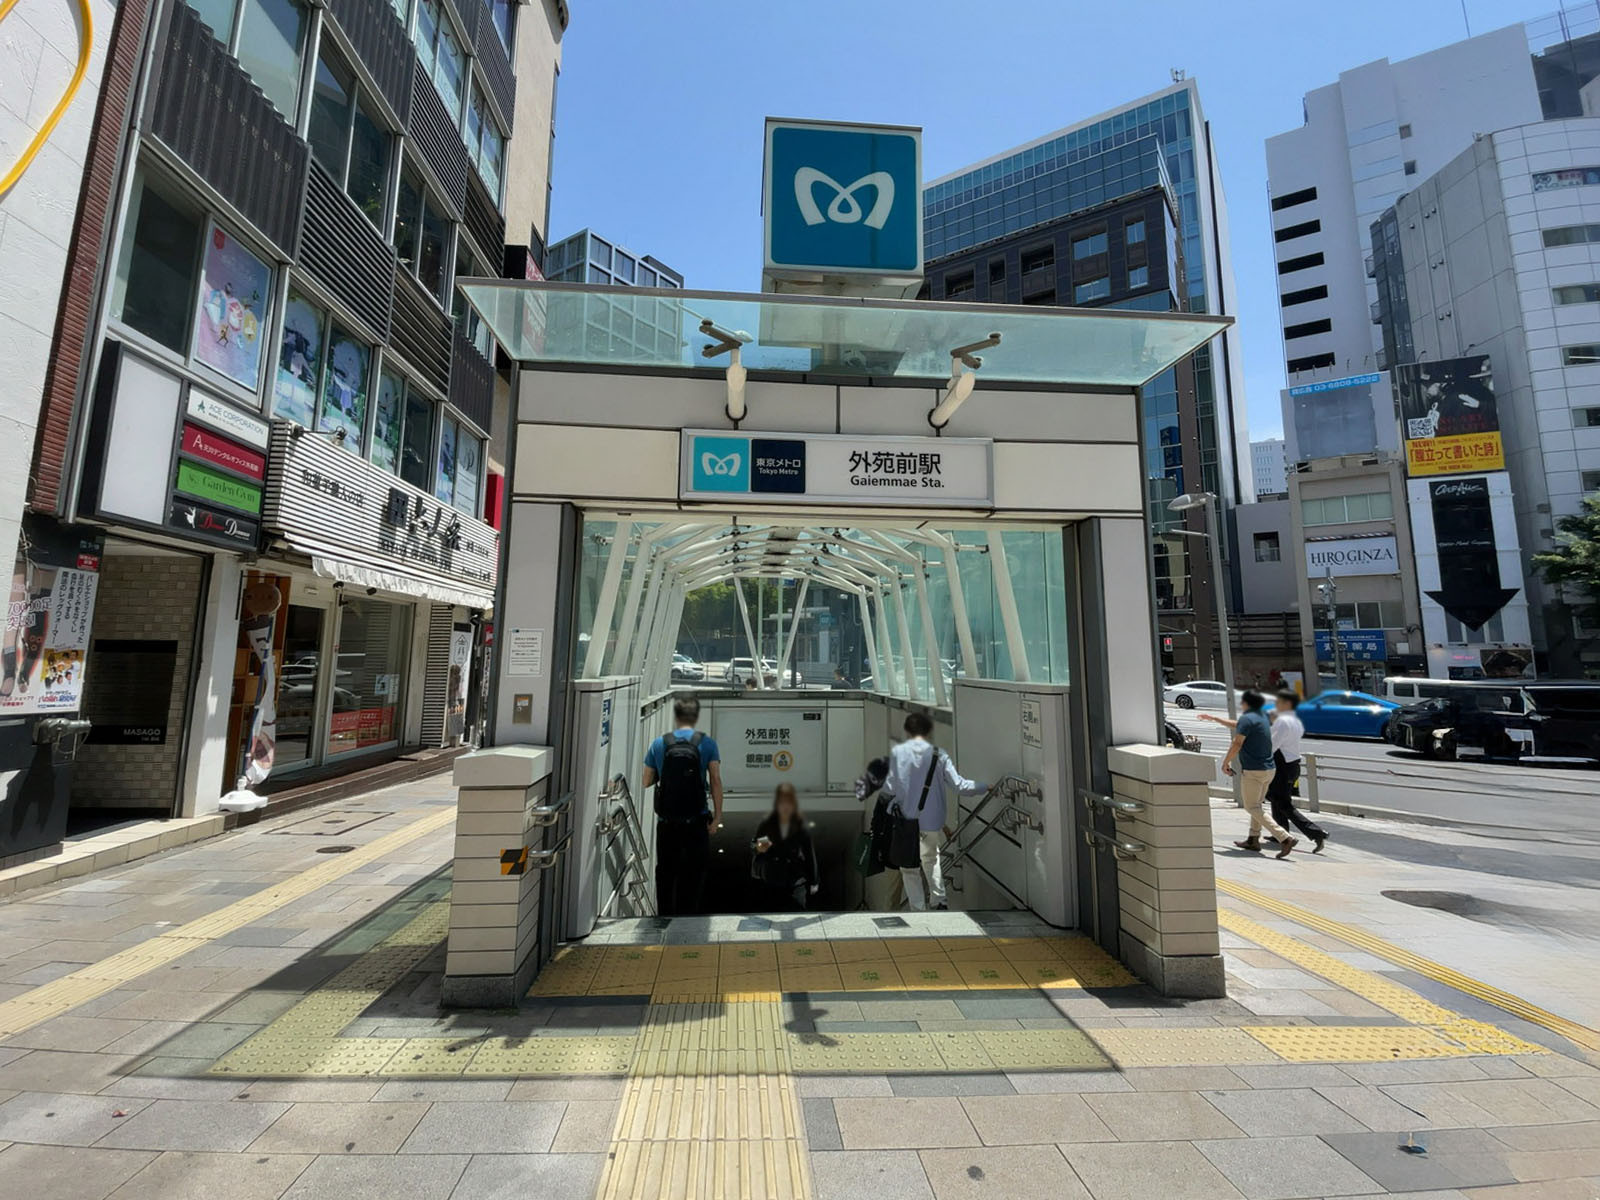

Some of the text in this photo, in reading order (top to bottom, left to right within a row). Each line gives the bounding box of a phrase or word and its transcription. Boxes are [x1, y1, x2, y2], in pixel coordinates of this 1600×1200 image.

[756, 457, 801, 468] 東京メトロ
[849, 450, 942, 476] 外苑前駅
[851, 475, 945, 488] Gaiemmae Sta.
[1310, 548, 1393, 565] HIRO GINZA
[123, 728, 161, 736] MASAGO
[745, 728, 790, 739] 外苑前駅
[746, 754, 773, 763] 銀座線
